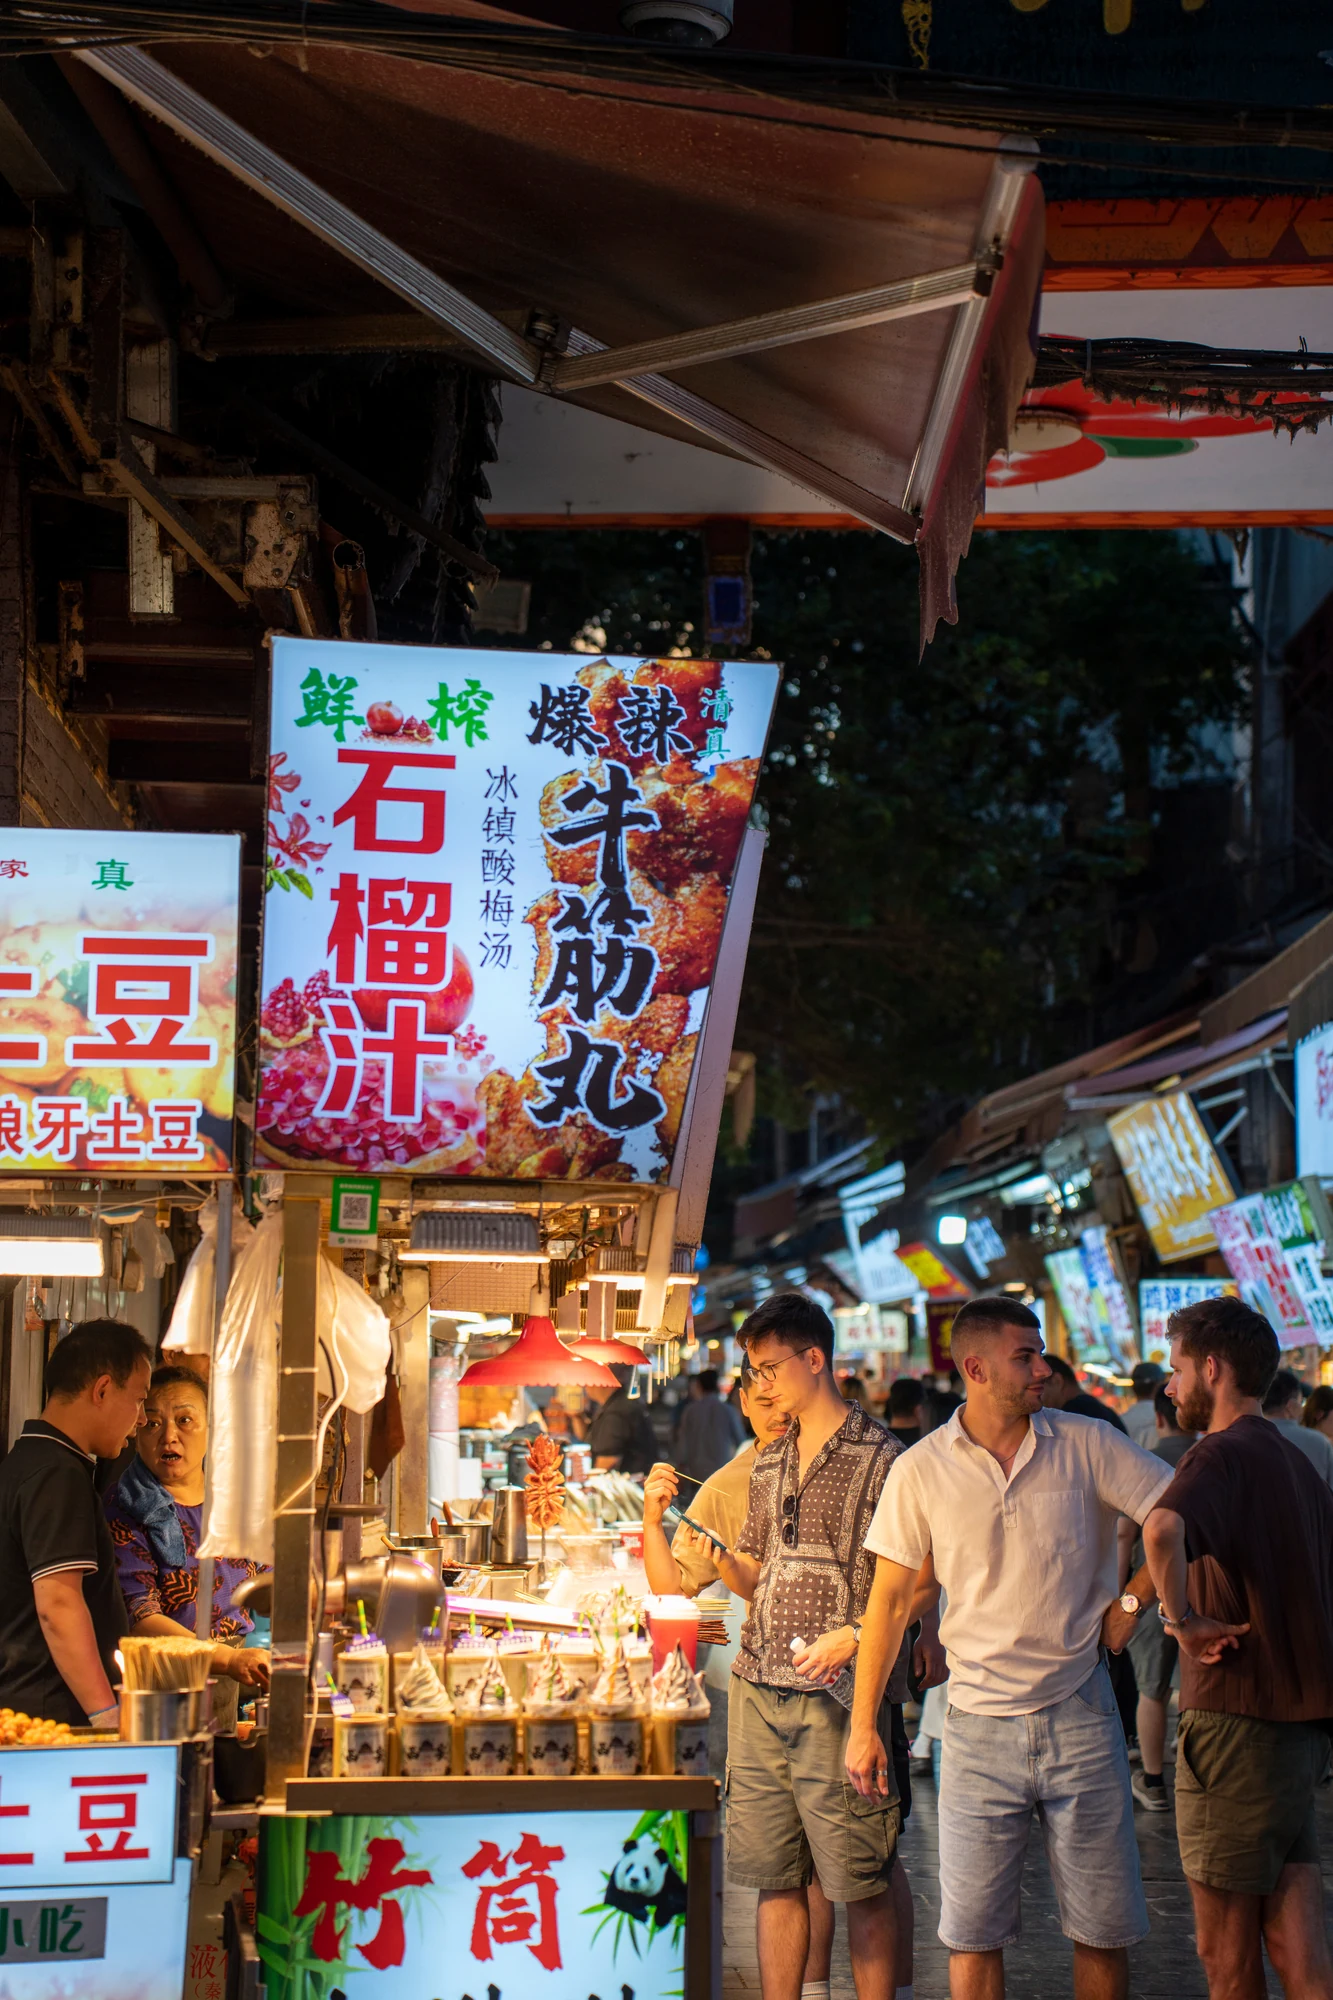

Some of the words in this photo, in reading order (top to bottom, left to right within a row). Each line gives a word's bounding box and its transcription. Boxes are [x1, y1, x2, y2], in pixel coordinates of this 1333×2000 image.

[294, 667, 494, 747] 鲜榨
[525, 683, 693, 763] 爆辣
[696, 687, 734, 760] 清真
[91, 858, 135, 891] 真
[478, 765, 519, 970] 冰镇酸梅汤
[320, 748, 457, 1118] 石榴汁
[527, 764, 665, 1131] 牛筋丸
[293, 1832, 566, 1972] 竹筒
